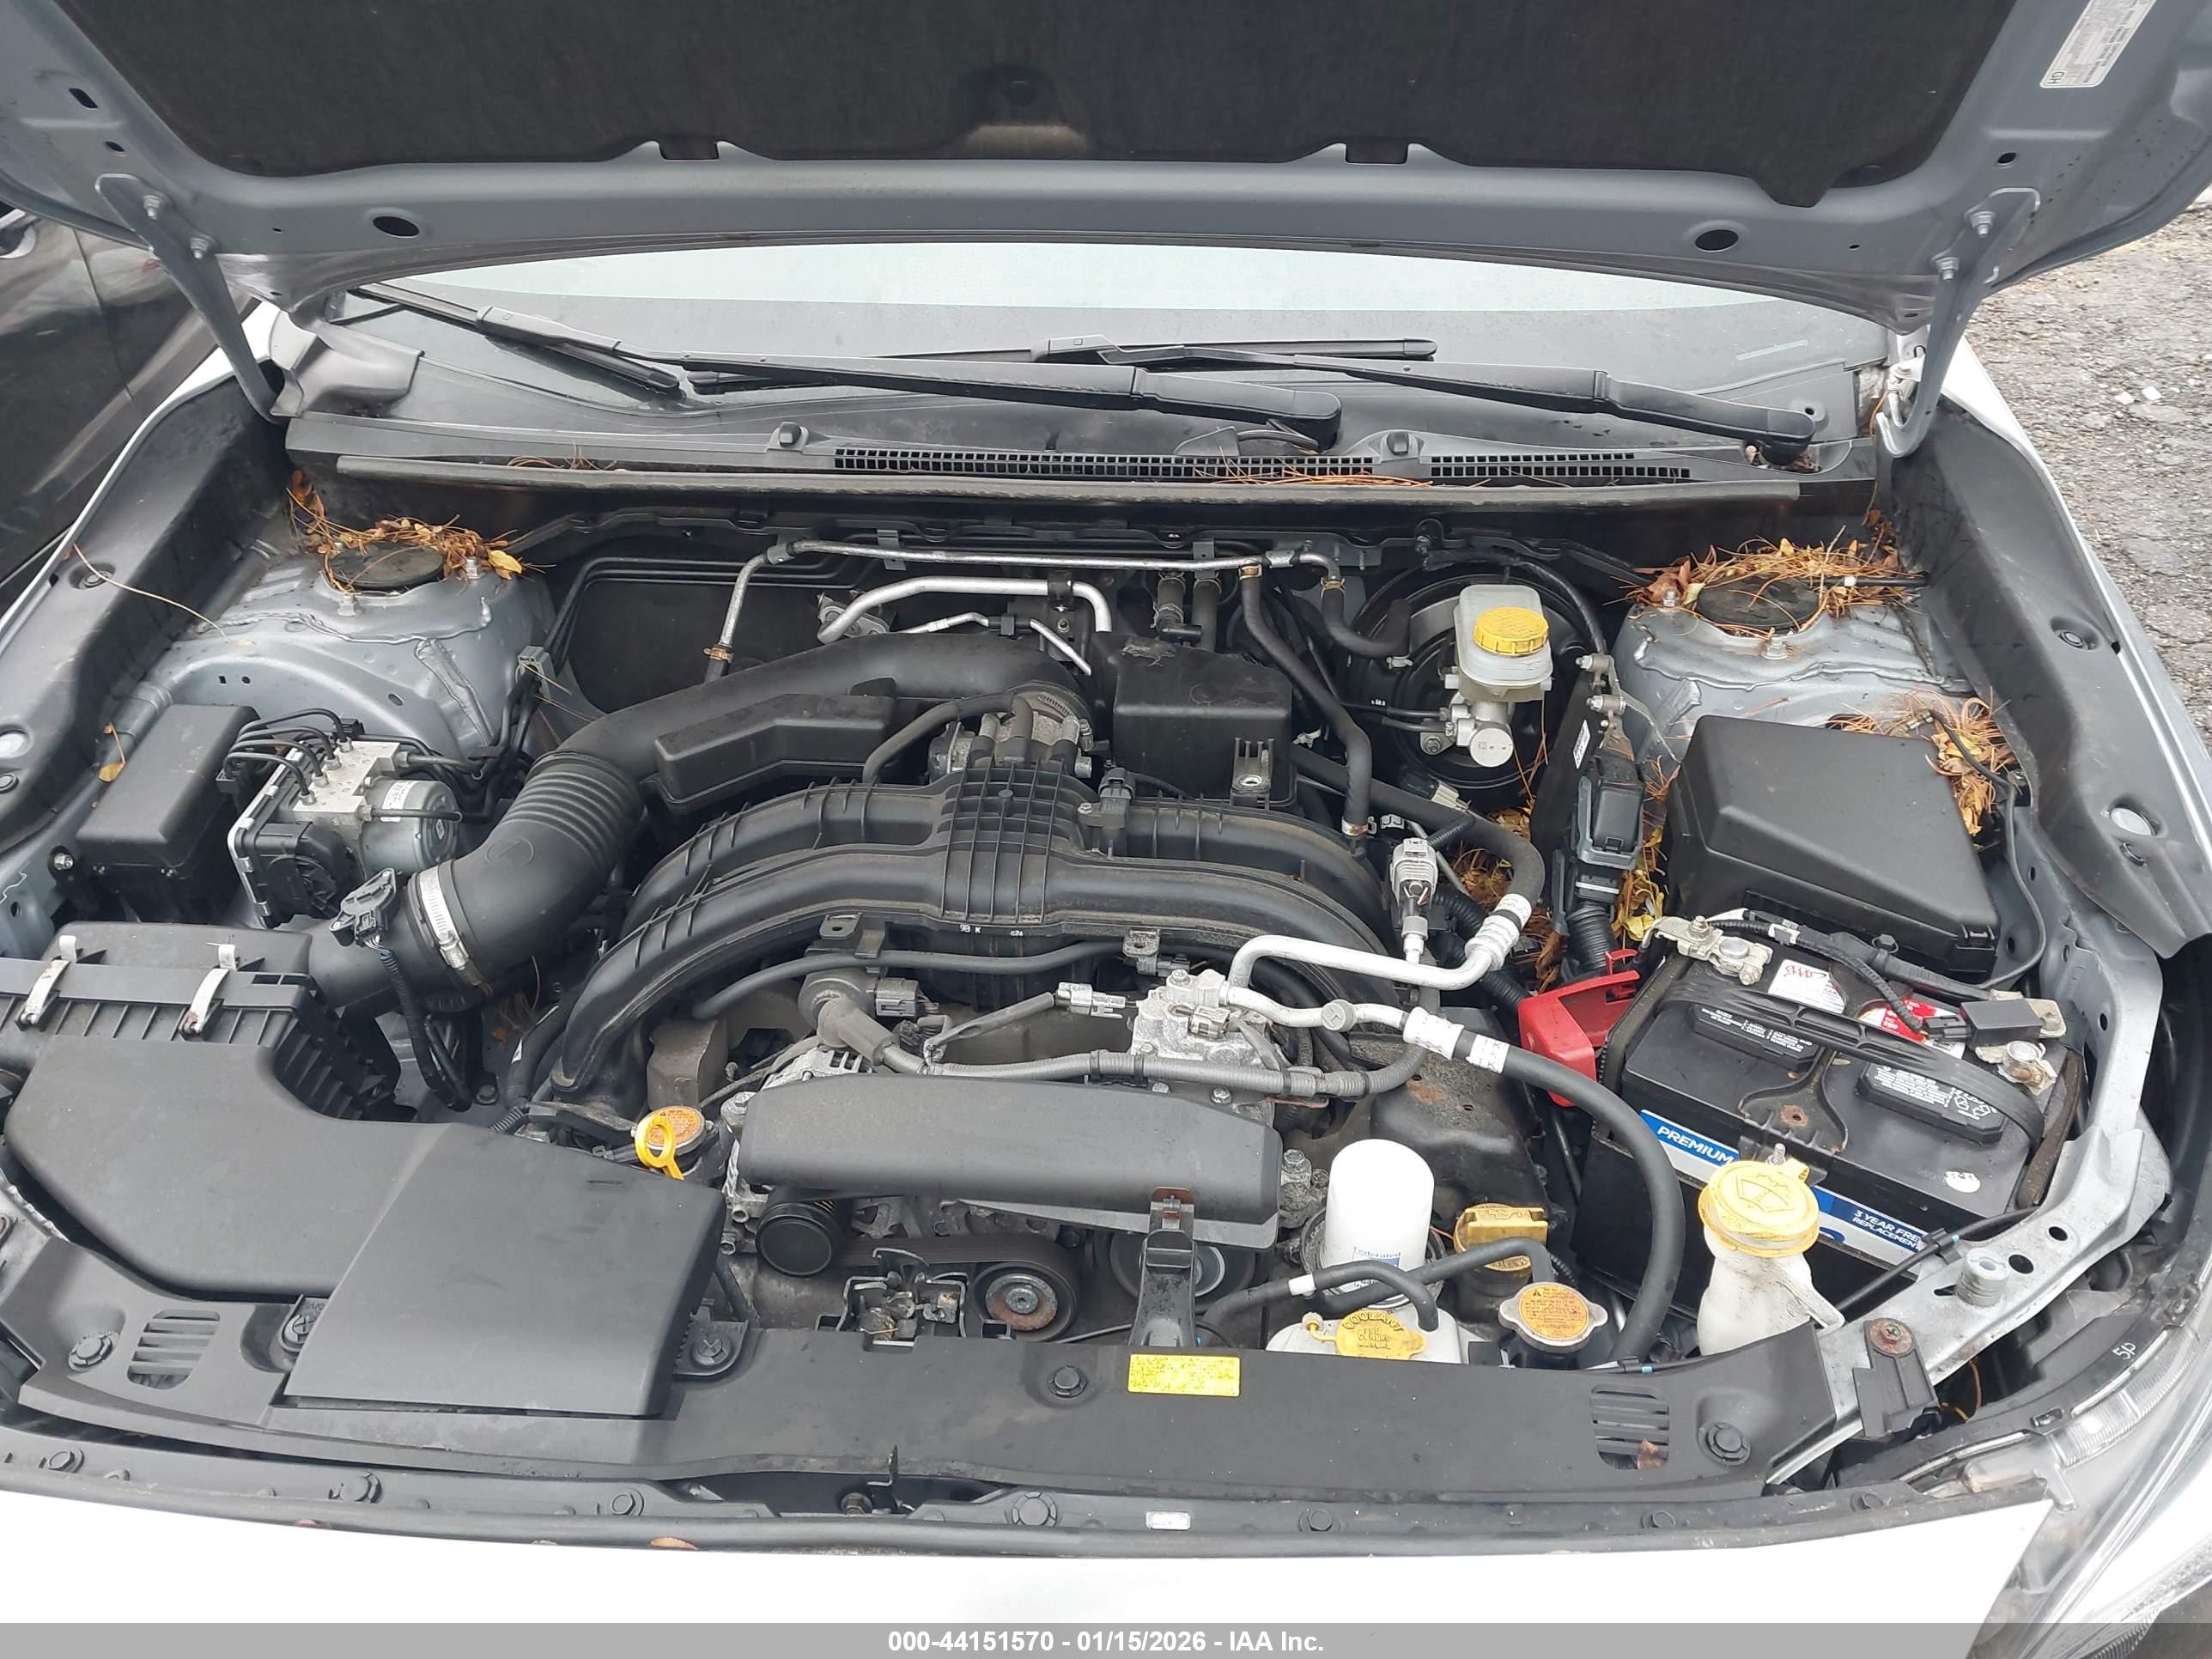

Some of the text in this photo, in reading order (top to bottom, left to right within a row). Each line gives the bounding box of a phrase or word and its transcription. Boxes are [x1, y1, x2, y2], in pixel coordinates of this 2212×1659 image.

[2047, 70, 2065, 84] GH
[1656, 1125, 1735, 1164] PREMIUM
[1854, 1209, 1863, 1218] 3
[1864, 1213, 1895, 1231] YEAR
[1342, 1311, 1405, 1332] COOLANT
